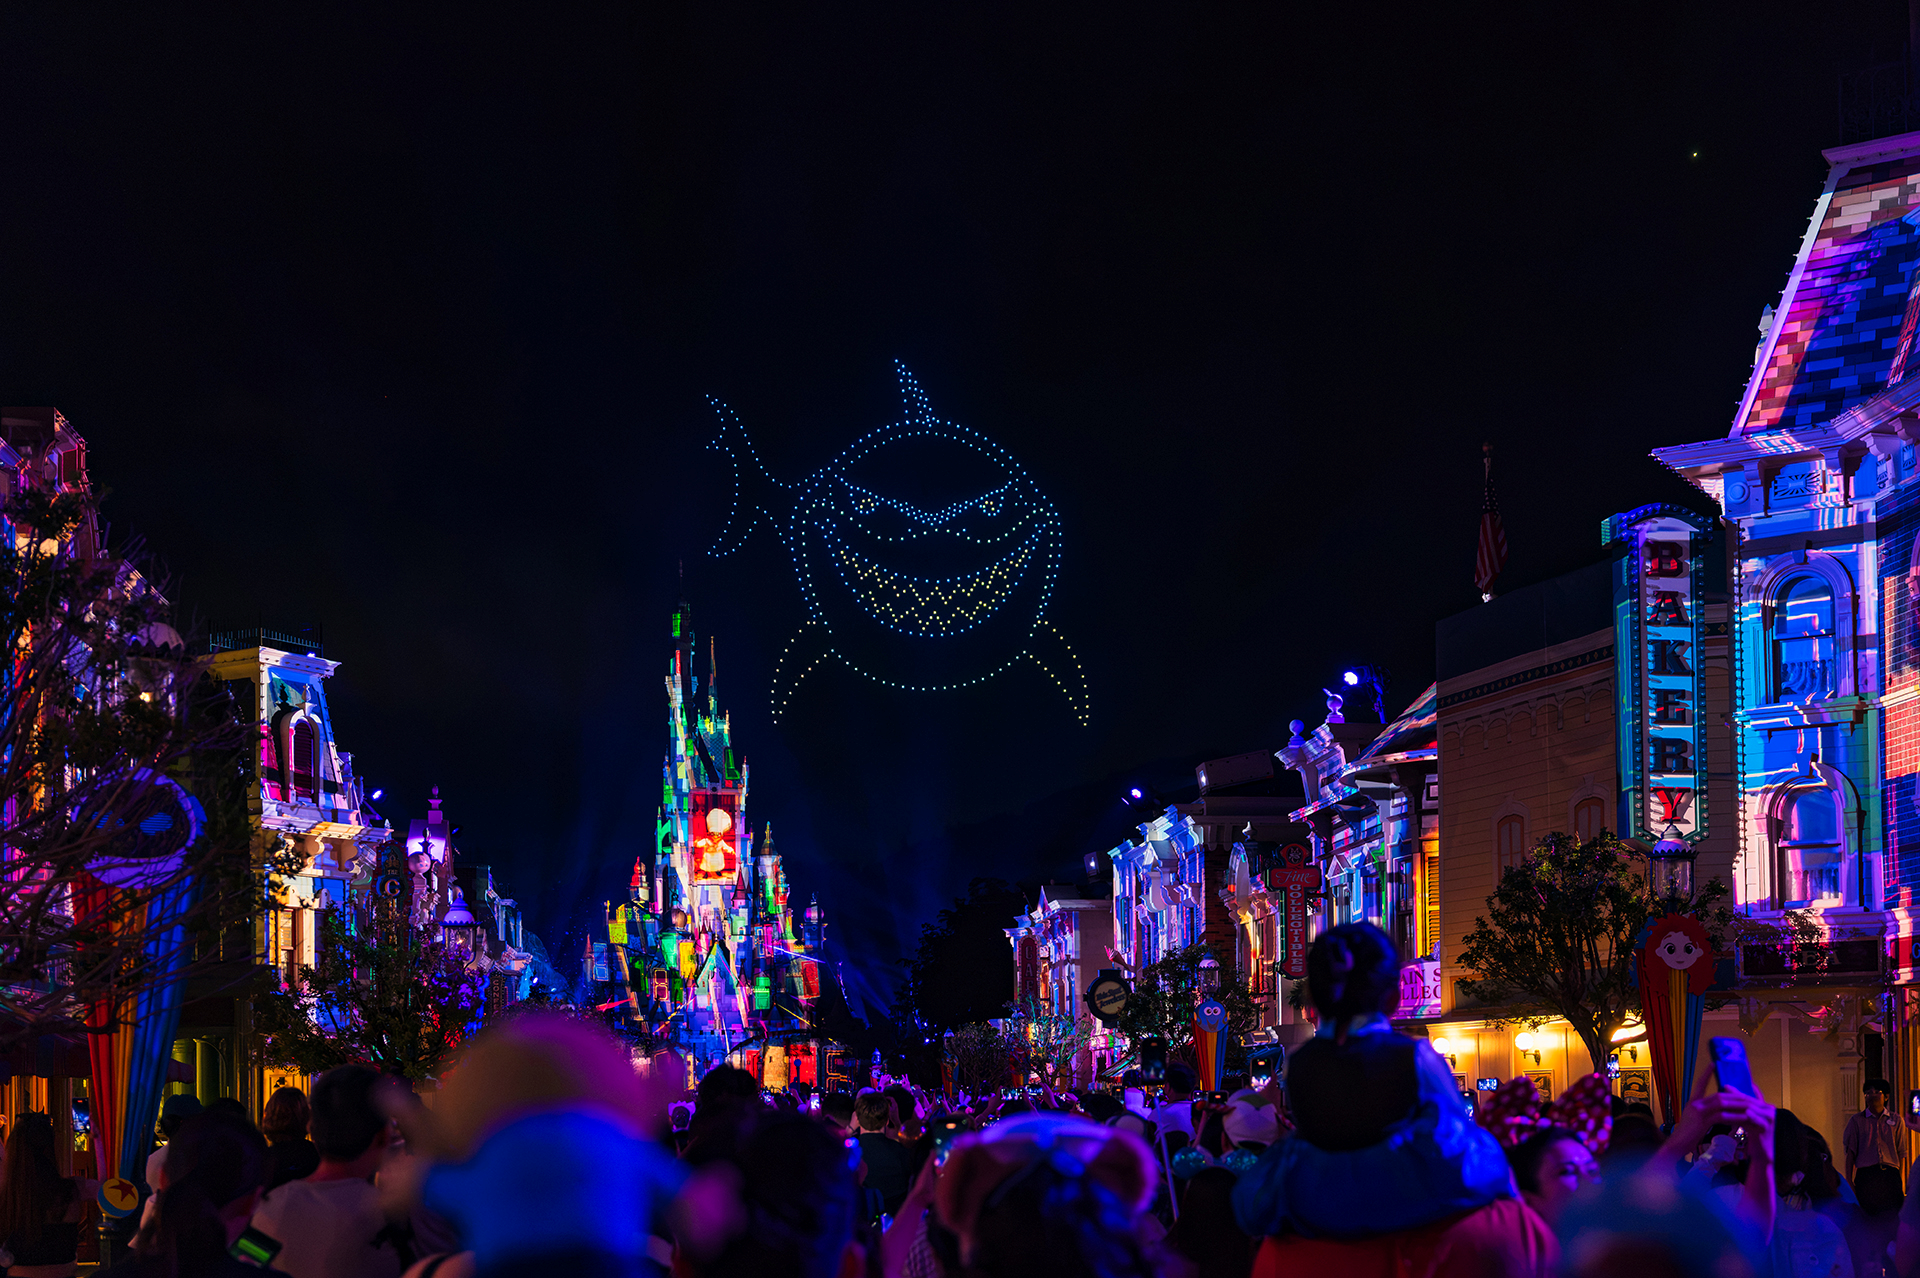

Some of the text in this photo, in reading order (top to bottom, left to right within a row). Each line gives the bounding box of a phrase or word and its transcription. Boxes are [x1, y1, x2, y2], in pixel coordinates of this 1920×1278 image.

[1646, 541, 1694, 822] BAKERY
[1275, 870, 1316, 885] Fine
[1289, 884, 1304, 973] COLLECTIBLES
[1025, 945, 1035, 991] CAF
[1399, 969, 1425, 986] AIN
[1401, 984, 1441, 1000] LLEC
